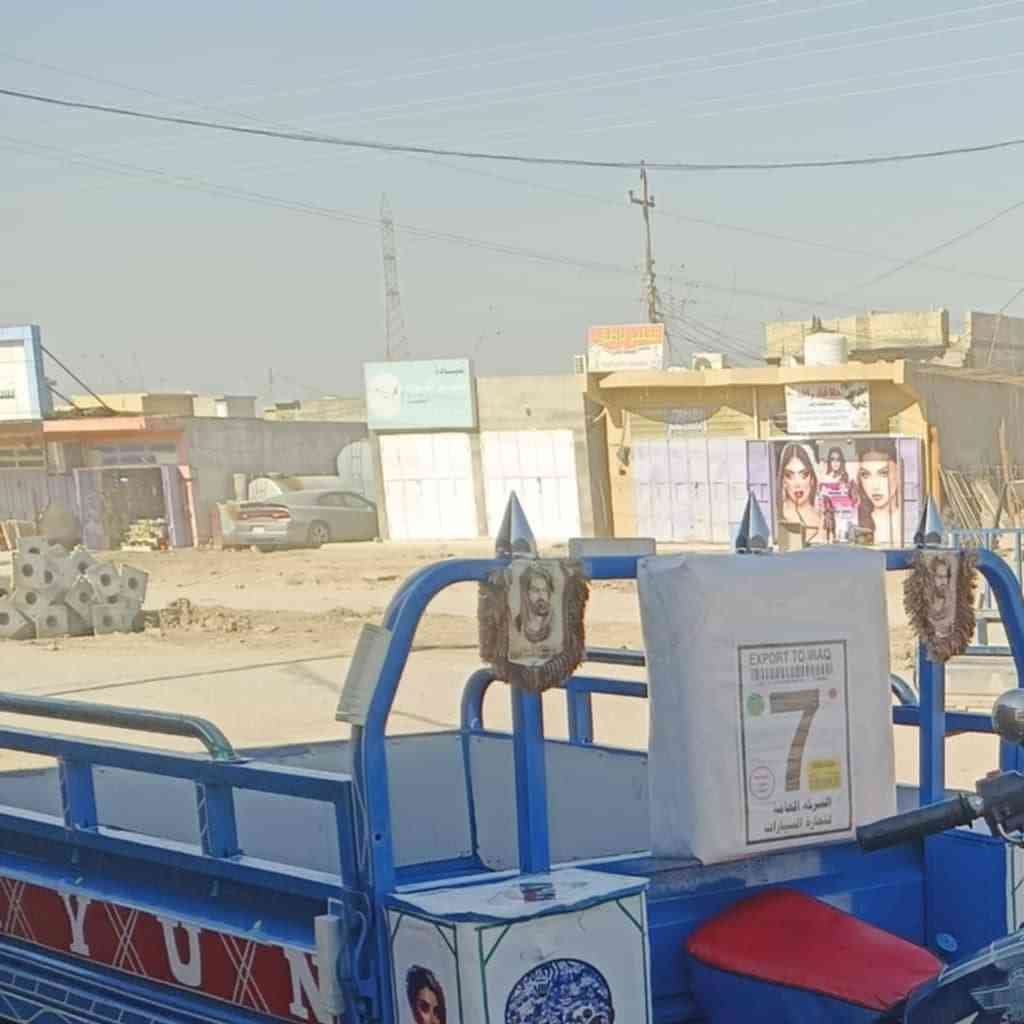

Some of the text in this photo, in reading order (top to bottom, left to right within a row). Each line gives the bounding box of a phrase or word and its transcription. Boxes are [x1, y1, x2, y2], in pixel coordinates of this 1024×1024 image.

[750, 647, 832, 666] EXPORT TO IRAQ
[769, 688, 820, 793] 7
